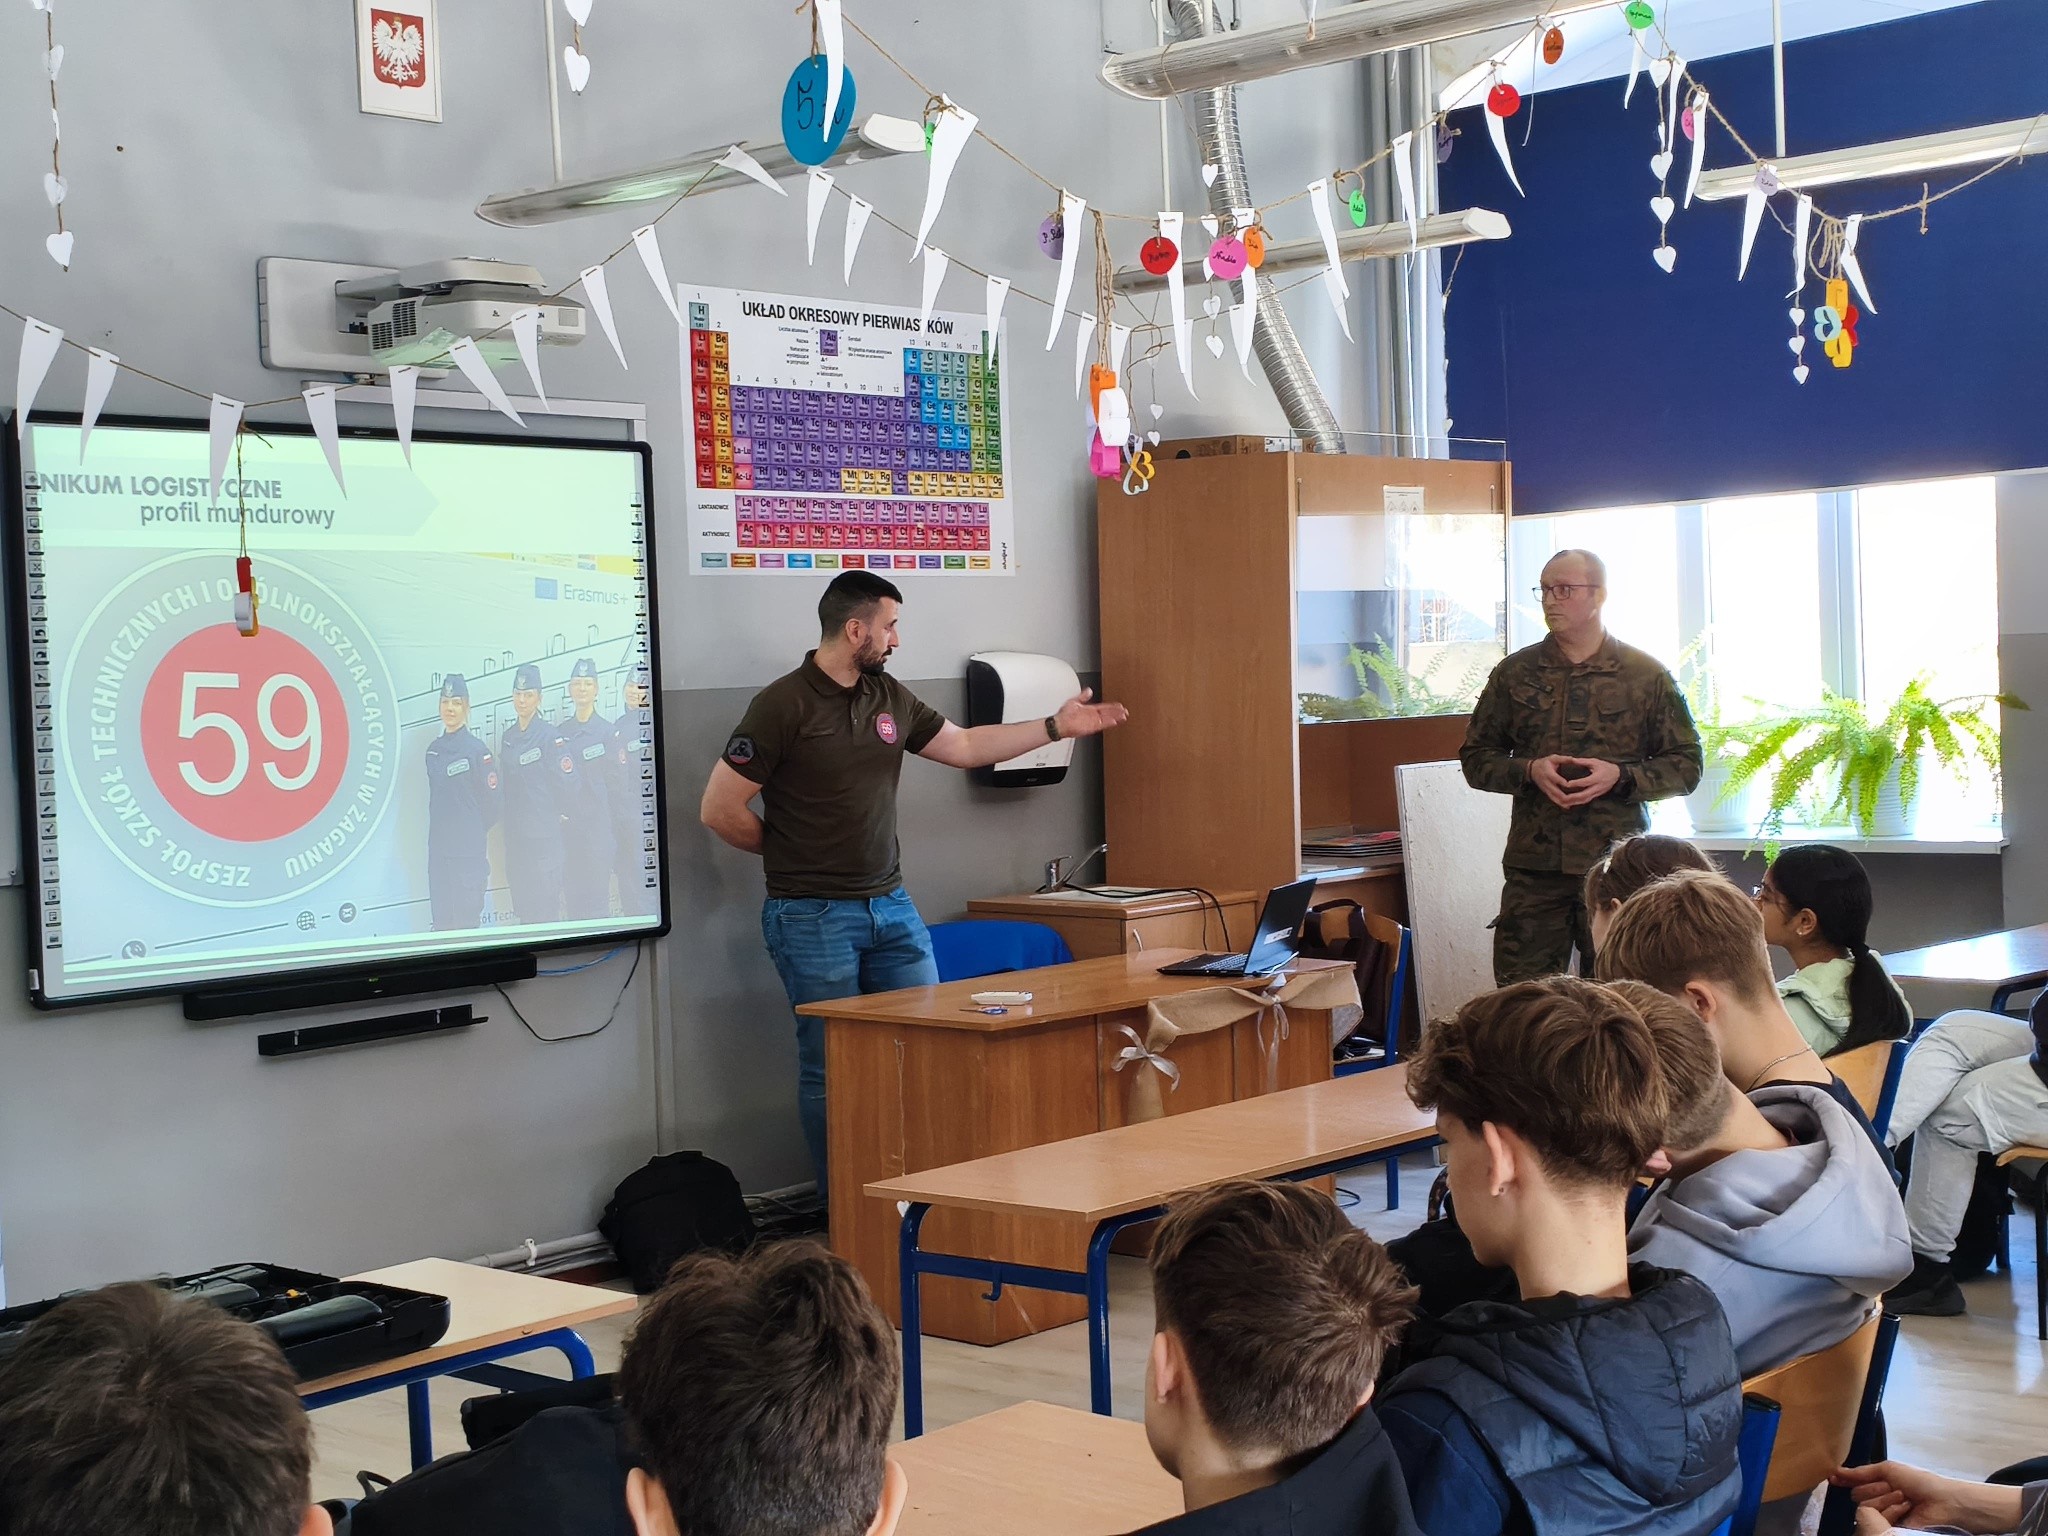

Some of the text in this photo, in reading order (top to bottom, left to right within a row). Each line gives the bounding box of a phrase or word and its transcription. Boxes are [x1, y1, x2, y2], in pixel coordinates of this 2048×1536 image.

[742, 301, 953, 335] UKŁAD OKRESOWY PIERWIASKÓW
[716, 334, 725, 342] Be
[826, 333, 836, 341] Au
[716, 360, 728, 370] Mg
[912, 375, 918, 383] Al
[974, 380, 981, 388] Cl
[990, 381, 996, 389] Ar
[718, 386, 727, 395] Ca
[737, 388, 746, 397] Sc
[792, 392, 800, 400] Cr
[808, 393, 820, 401] Mn
[827, 394, 835, 402] Fe
[877, 397, 887, 405] Cu
[894, 398, 903, 406] Zn
[959, 403, 967, 411] Se
[720, 413, 728, 421] Sr
[758, 415, 765, 423] Zr
[775, 416, 784, 425] Nb
[791, 417, 803, 426] Mo
[811, 418, 819, 426] Tc
[827, 419, 837, 427] Ru
[844, 420, 854, 428] Rh
[862, 421, 871, 429] Pd
[879, 422, 887, 432] Ag
[895, 423, 904, 431] Cd
[944, 426, 952, 434] Sb
[960, 427, 968, 435] Te
[721, 439, 731, 448] Ba
[758, 441, 767, 449] Hf
[777, 442, 785, 450] Ta
[811, 444, 820, 452] Re
[828, 445, 838, 453] Os
[863, 446, 871, 454] Pt
[879, 447, 889, 455] Au
[895, 447, 905, 457] Hg
[928, 449, 937, 457] Pb
[721, 465, 731, 474] Ra
[759, 467, 768, 475] Rf
[777, 468, 787, 476] Db
[795, 468, 804, 478] Sg
[812, 469, 822, 477] Bh
[830, 470, 839, 478] Hs
[847, 470, 857, 478] Mt
[864, 471, 873, 479] Ds
[880, 472, 890, 481] Rg
[931, 473, 937, 481] Fl
[977, 475, 984, 483] Ts
[993, 476, 1001, 485] Og
[40, 474, 282, 499] NIKUM LOGISTCZNE
[140, 502, 335, 529] profil mundurowy
[742, 498, 751, 506] La
[760, 498, 770, 507] Ce
[779, 499, 787, 507] Pr
[796, 499, 806, 508] Nd
[812, 500, 824, 508] Pm
[830, 500, 842, 509] Sm
[849, 501, 857, 509] Eu
[865, 501, 874, 509] Gd
[882, 502, 891, 510] Tb
[898, 502, 907, 512] Dy
[915, 503, 925, 511] Ho
[932, 503, 939, 511] Er
[947, 504, 956, 512] Tm
[963, 504, 972, 512] Yb
[743, 524, 753, 532] Ac
[762, 524, 771, 532] Th
[779, 524, 789, 533] Pa
[814, 525, 824, 535] Np
[832, 525, 841, 534] Pu
[883, 526, 891, 534] Bk
[564, 583, 629, 604] Erasmus+
[90, 576, 385, 887] ZESPÓŁ SZKÓŁ TECHNICZNYCH I OÓLNOKSZTAŁCĄCYCH W ŻAGANIU
[178, 671, 322, 796] 59
